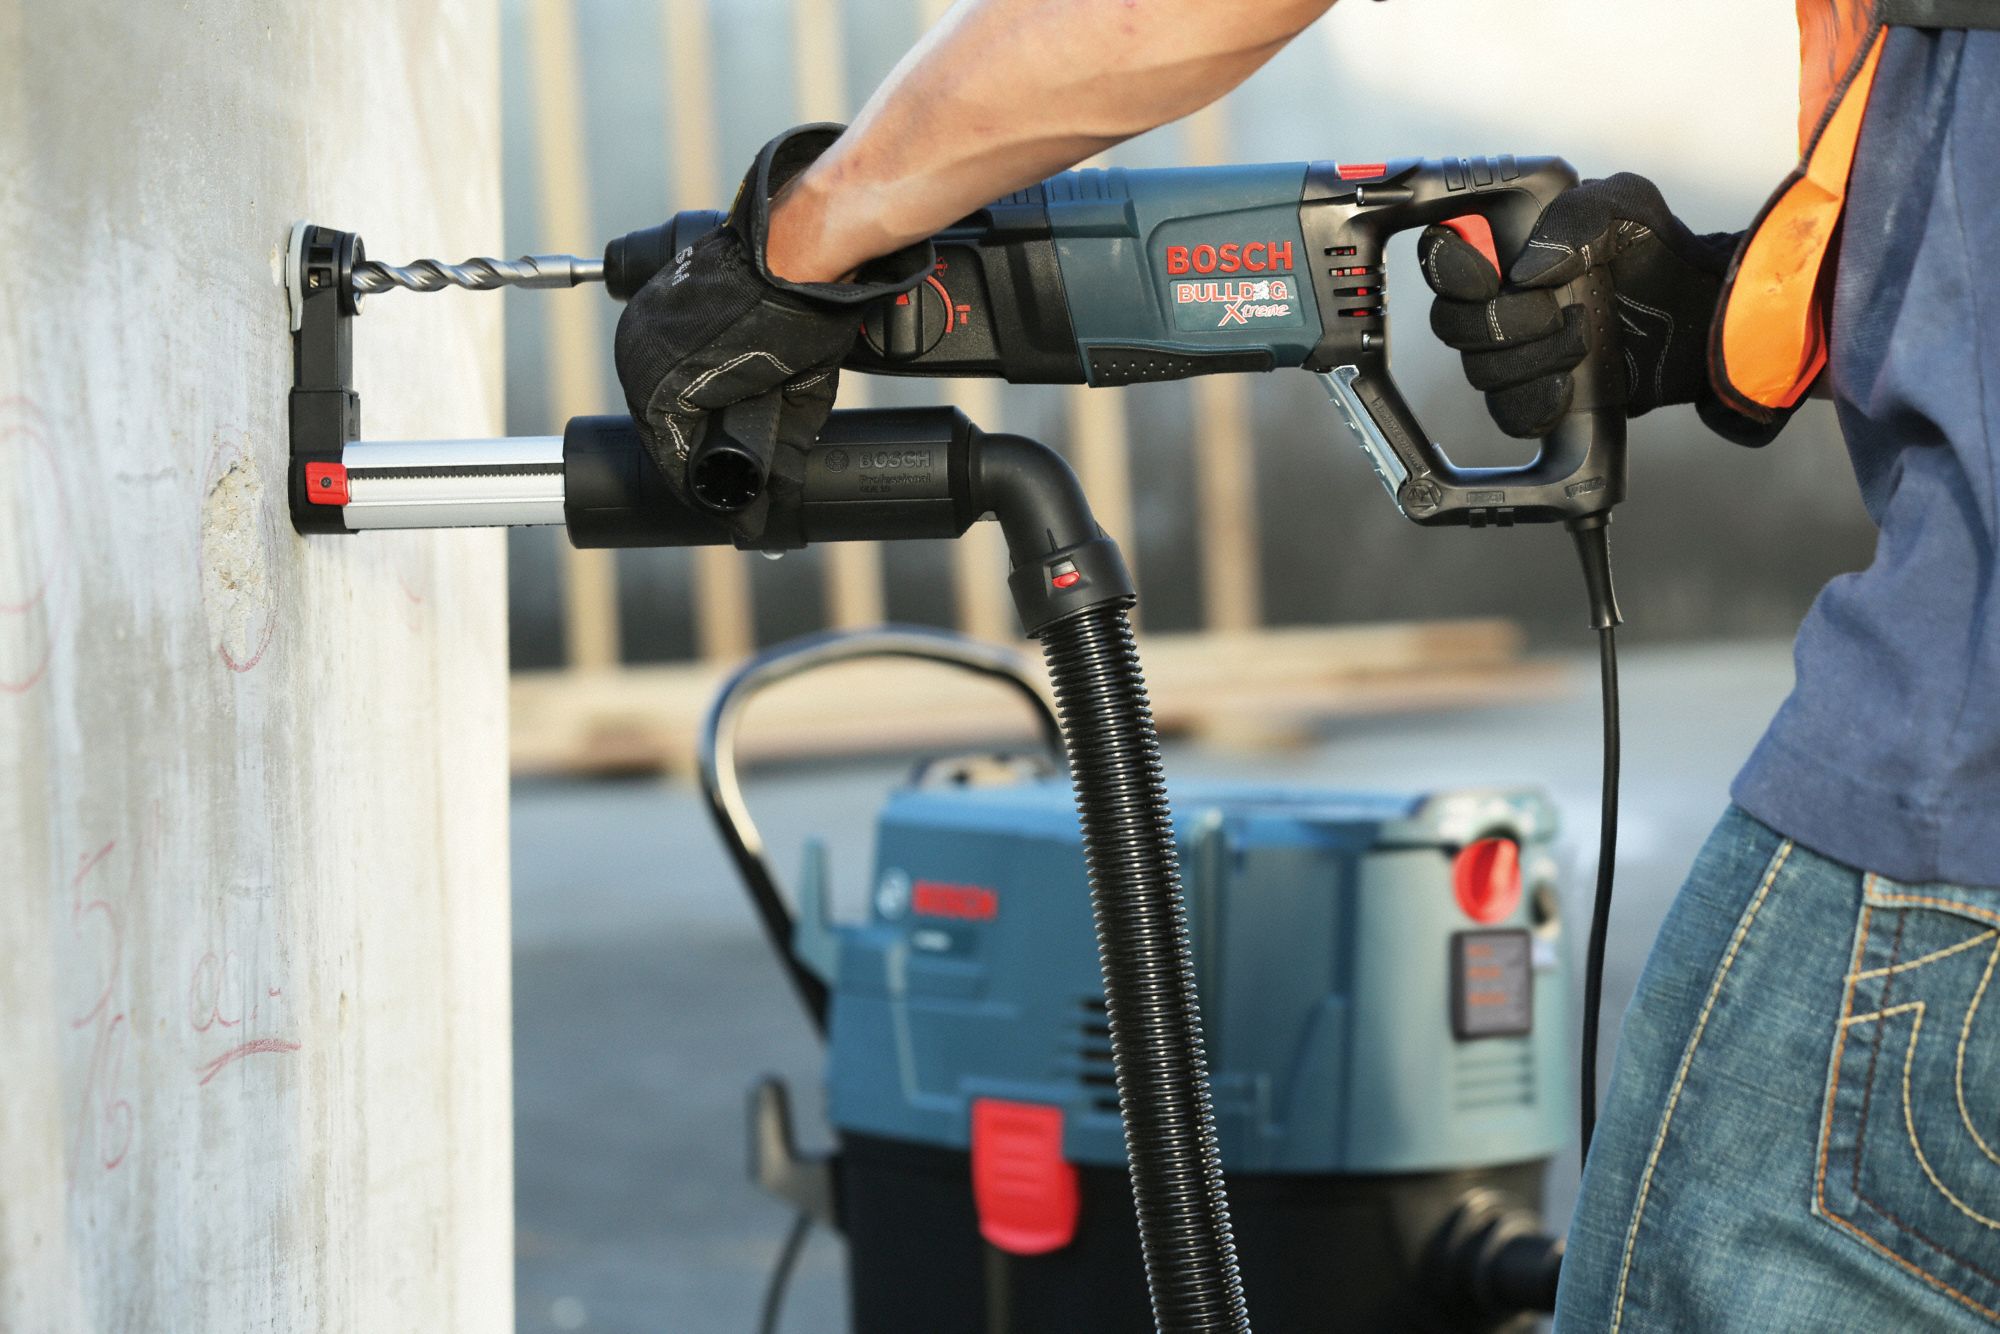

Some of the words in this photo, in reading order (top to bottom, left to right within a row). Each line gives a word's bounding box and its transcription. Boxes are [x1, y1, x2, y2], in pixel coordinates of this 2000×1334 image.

[1166, 240, 1293, 275] BOSCH
[1217, 299, 1291, 327] Xtreme
[858, 450, 931, 469] BOSCH
